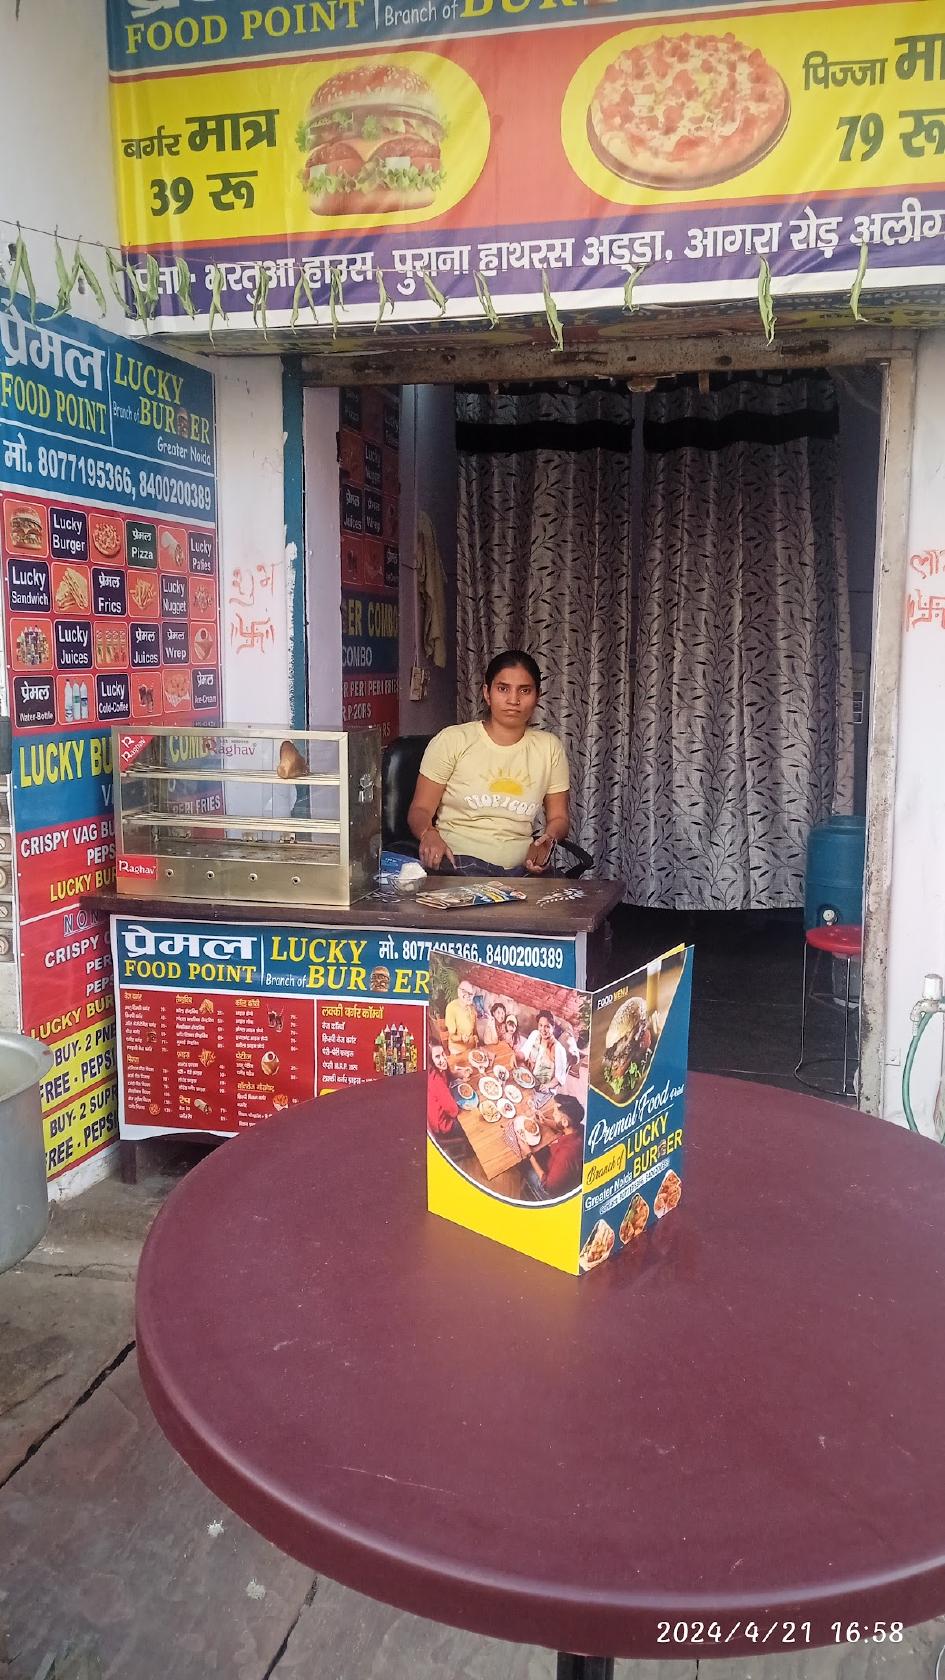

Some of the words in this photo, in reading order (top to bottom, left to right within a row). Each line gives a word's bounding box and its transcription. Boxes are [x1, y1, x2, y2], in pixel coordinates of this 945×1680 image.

[385, 4, 437, 26] Branch
[443, 2, 459, 20] of
[124, 15, 228, 54] FOOD
[241, 0, 365, 40] POINT
[804, 51, 888, 91] पिज्जा
[121, 125, 182, 160] बर्गर
[184, 109, 279, 153] मात्र
[836, 112, 884, 162] 79
[150, 177, 194, 216] 39
[206, 171, 258, 212] रू
[392, 245, 471, 295] पुराना
[477, 238, 575, 277] हाथरस
[684, 221, 782, 259] आगरा
[0, 298, 105, 391] प्रेमल
[114, 352, 183, 405] LUCKY
[1, 372, 50, 418] FOOD
[55, 389, 107, 435] POINT
[157, 436, 188, 459] Greater
[190, 446, 211, 466] Noida
[3, 431, 33, 473] मो.
[38, 447, 136, 500] 8077195366,
[139, 470, 212, 511] 8400200389
[53, 513, 82, 535] Lucky
[52, 534, 85, 554] Burger
[131, 547, 154, 560] Pizza
[190, 538, 212, 557] Lucky
[12, 566, 46, 591] Lucky
[98, 571, 121, 588] प्रेमल
[163, 578, 185, 597] Lucky
[11, 590, 48, 606] Sandwich
[163, 598, 187, 615] Nugget
[58, 624, 88, 647] Lucky
[135, 627, 156, 643] प्रेमल
[60, 650, 89, 665] Juices
[133, 651, 158, 664] Juices
[21, 681, 50, 703] प्रेमल
[101, 681, 125, 700] Lucky
[20, 739, 84, 788] LUCKY
[195, 796, 221, 814] FRIES
[21, 828, 69, 858] CRISPY
[73, 824, 98, 845] VAG
[119, 860, 156, 875] Raghav
[50, 874, 96, 902] LUCKY
[44, 934, 99, 968] CRISPY
[121, 925, 257, 960] प्रेमल
[271, 936, 367, 964] LUCKY
[379, 934, 398, 960] मो.
[486, 944, 563, 969] 8400200389
[124, 959, 181, 979] FOOD
[188, 963, 257, 984] POINT
[266, 973, 295, 987] Branch
[297, 974, 307, 987] of
[597, 994, 613, 1011] FOOD
[30, 1006, 81, 1041] LUCKY
[85, 1033, 92, 1051] 2
[80, 1102, 87, 1121] 2
[588, 1099, 638, 1154] Premal
[638, 1080, 670, 1121] Food
[627, 1111, 669, 1160] LUCKY
[585, 1184, 614, 1209] Greater
[614, 1171, 633, 1192] Noida
